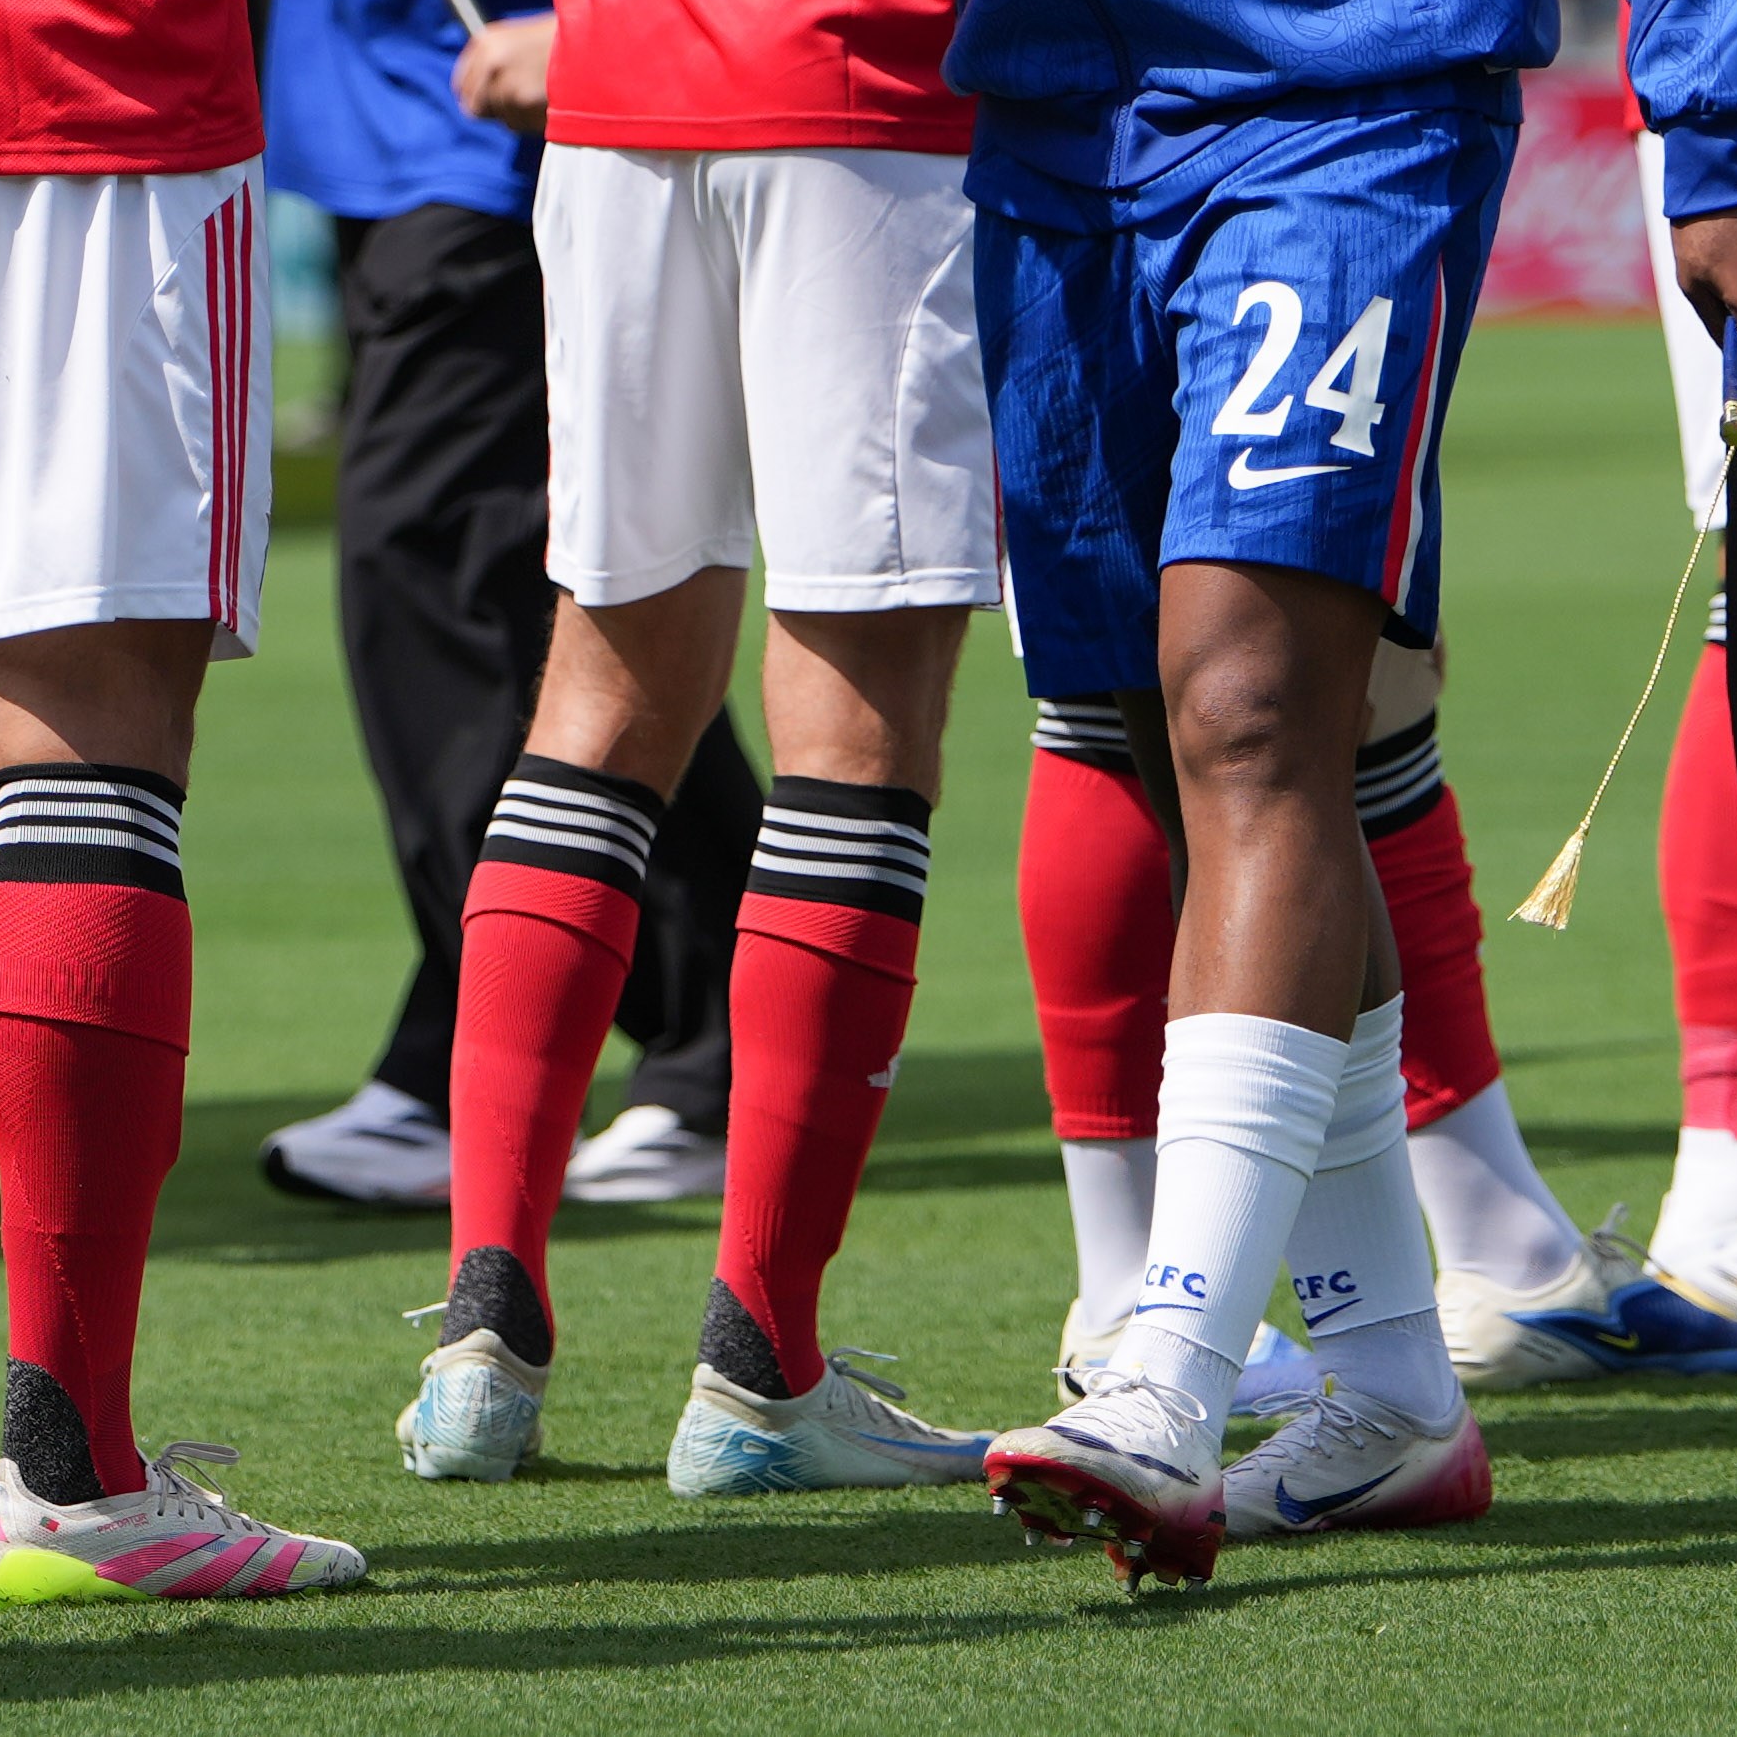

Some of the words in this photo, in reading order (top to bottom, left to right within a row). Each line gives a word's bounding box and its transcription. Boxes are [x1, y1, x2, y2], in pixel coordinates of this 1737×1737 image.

[1211, 280, 1394, 457] 24
[1145, 1263, 1207, 1299] CFC
[1292, 1270, 1357, 1301] CFC
